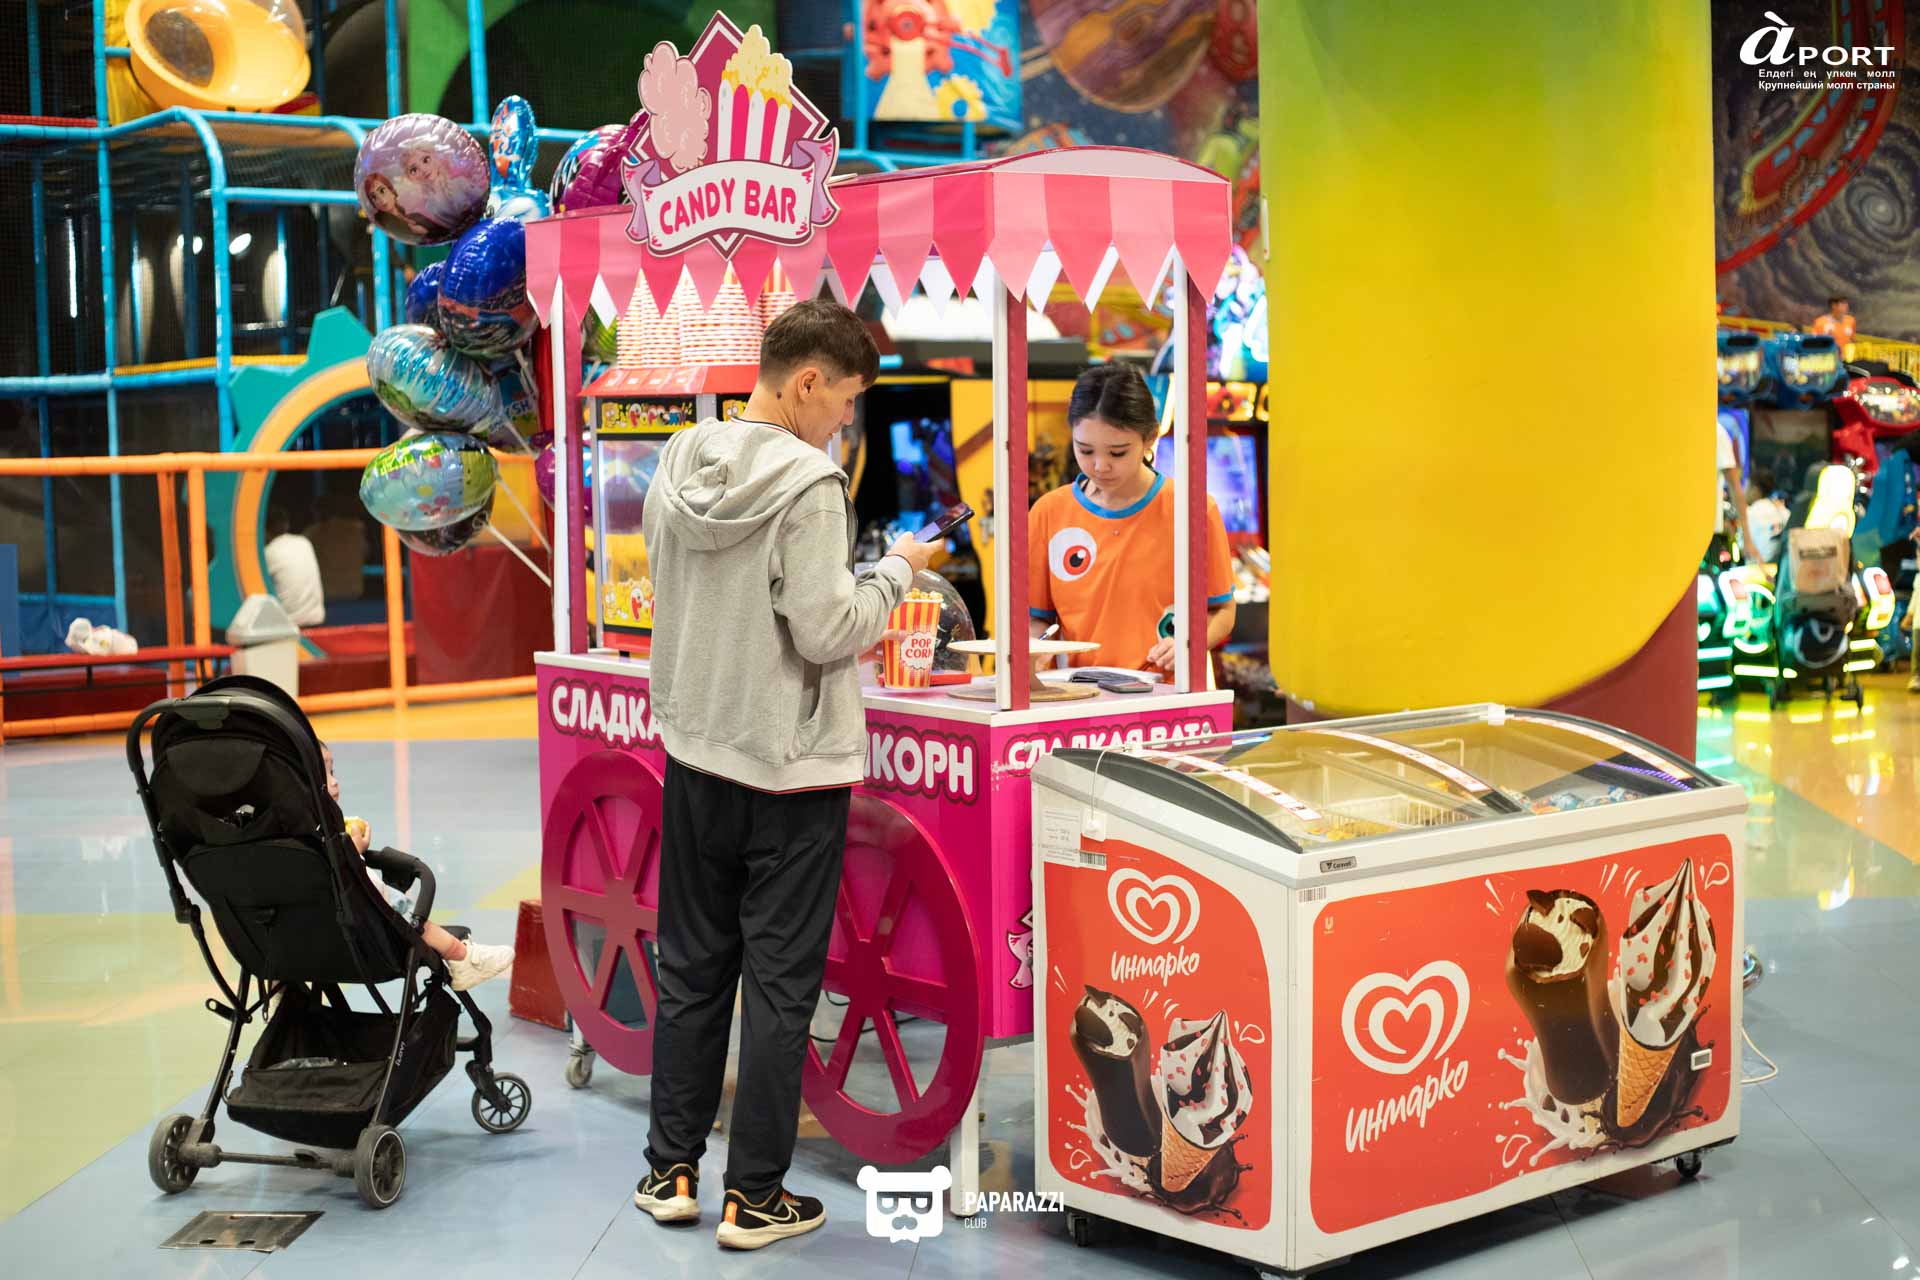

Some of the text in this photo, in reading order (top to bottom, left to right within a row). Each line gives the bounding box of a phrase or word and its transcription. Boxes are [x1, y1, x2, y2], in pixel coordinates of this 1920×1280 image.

[659, 177, 797, 235] CANDY BAR
[911, 638, 932, 648] POP
[1110, 945, 1200, 987] Инмарко
[1345, 1056, 1469, 1153] Инмарко
